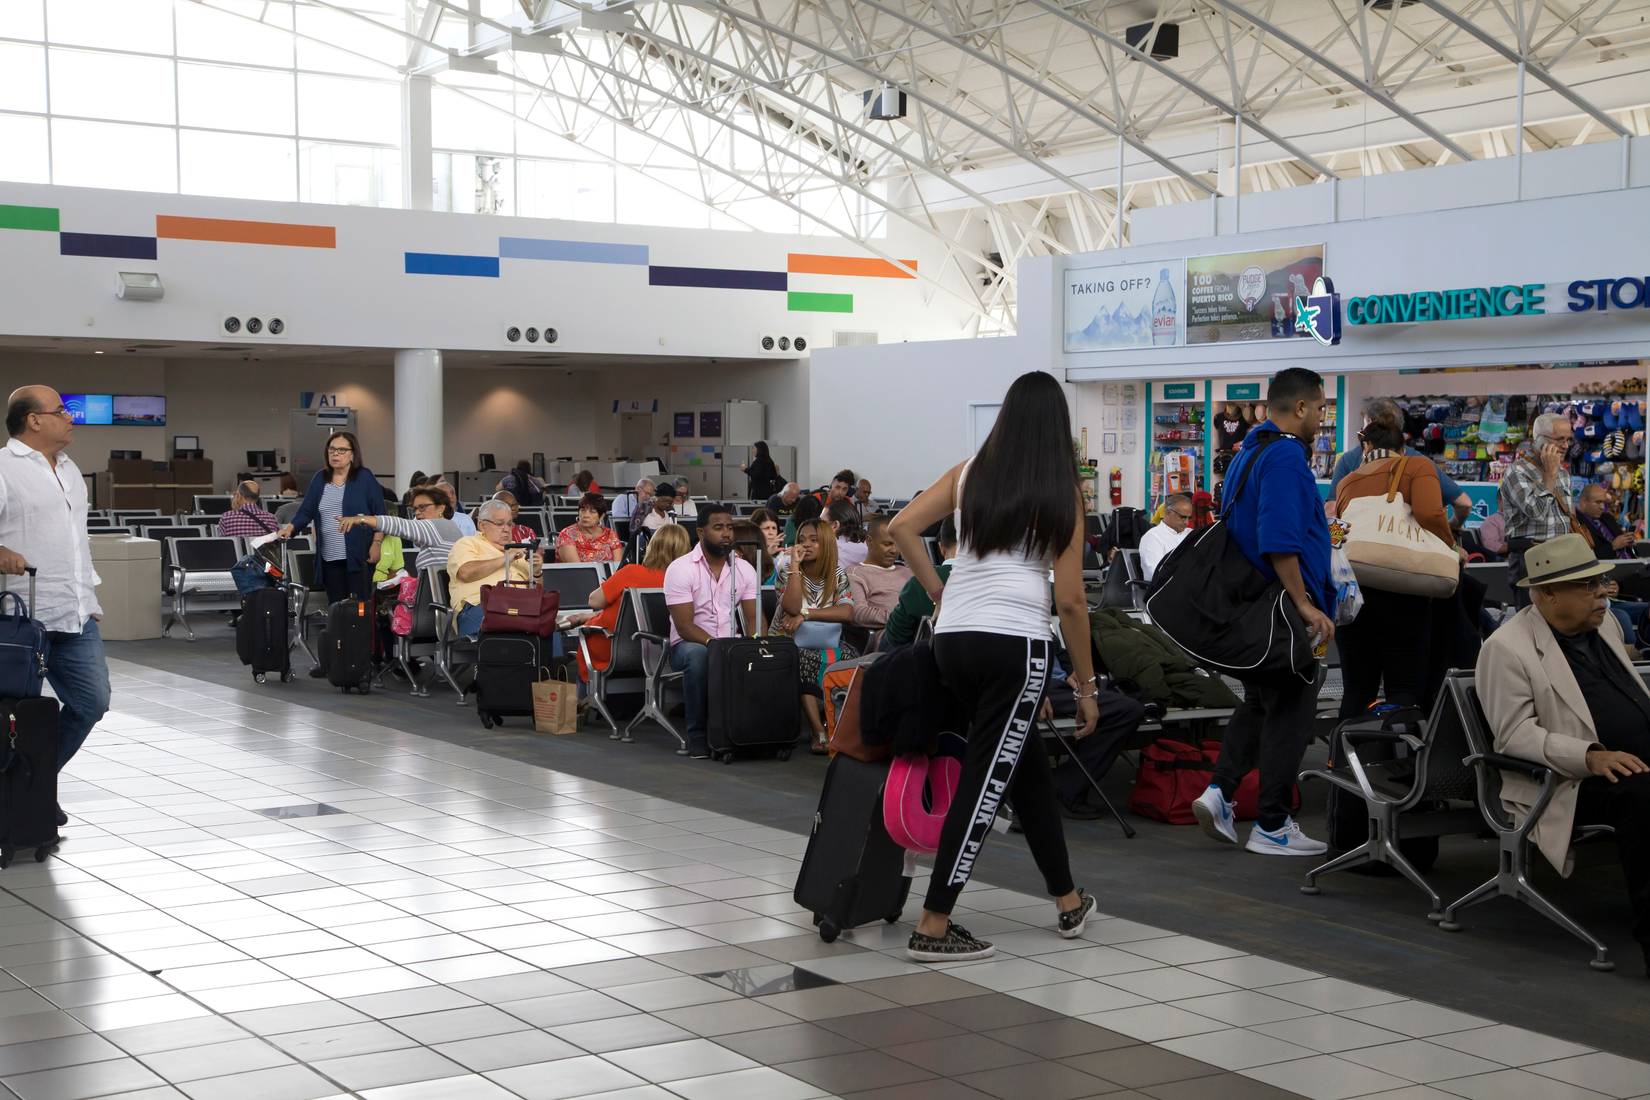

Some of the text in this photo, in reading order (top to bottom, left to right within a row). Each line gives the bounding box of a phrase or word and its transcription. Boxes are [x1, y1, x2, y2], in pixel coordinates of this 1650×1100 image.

[1071, 277, 1151, 295] TAKING OFF?
[1193, 275, 1212, 285] 100
[1192, 284, 1230, 295] COFFEE FROM
[1192, 293, 1233, 303] PUERTO RICO
[1347, 277, 1650, 325] CONVENIENCE STO
[1154, 315, 1176, 327] evian
[320, 394, 336, 406] A1
[1020, 657, 1045, 703] PINK
[997, 718, 1029, 764] PINK
[974, 778, 1006, 825] PINK
[952, 840, 981, 884] PINK
